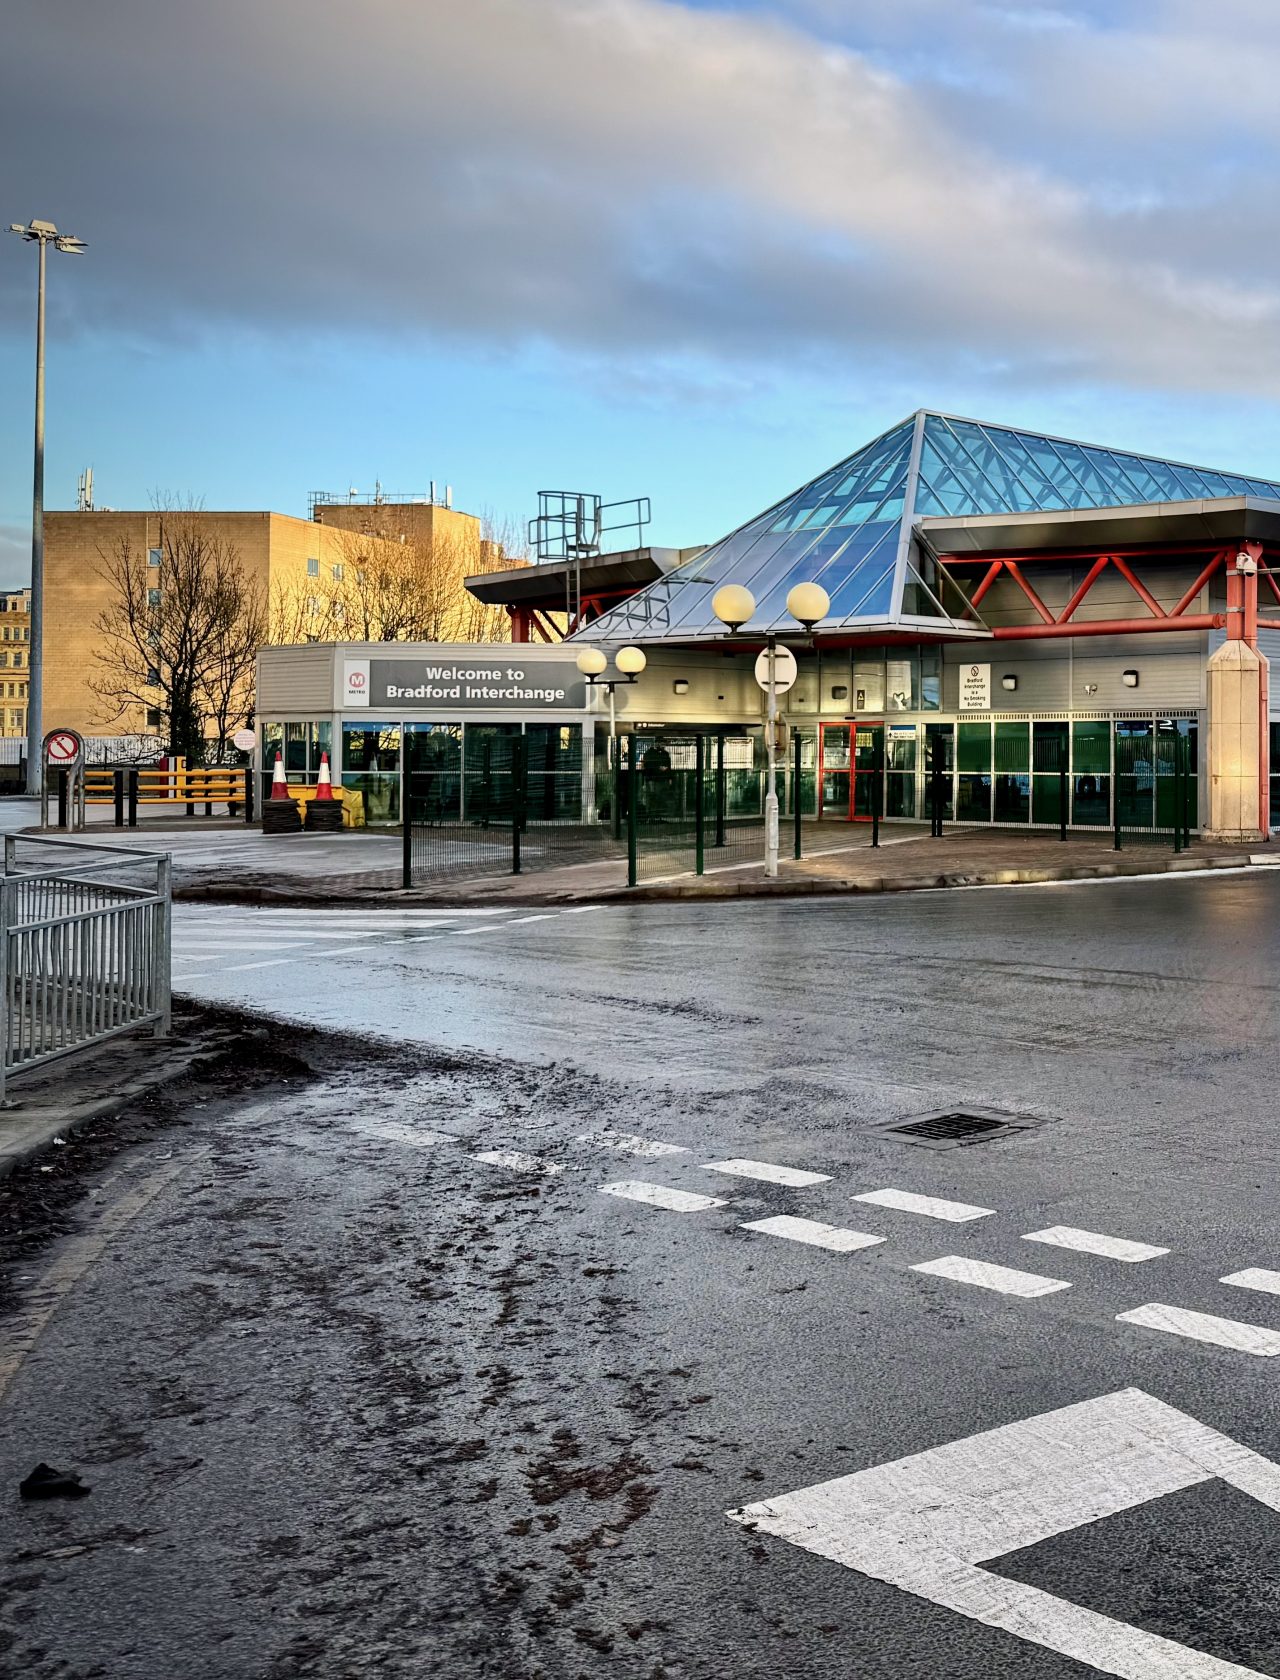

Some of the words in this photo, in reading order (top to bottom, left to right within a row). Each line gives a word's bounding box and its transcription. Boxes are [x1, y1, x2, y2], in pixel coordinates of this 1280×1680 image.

[426, 666, 502, 681] Welcome
[506, 667, 525, 681] to
[386, 684, 461, 699] Bradford
[465, 685, 565, 702] Interchange
